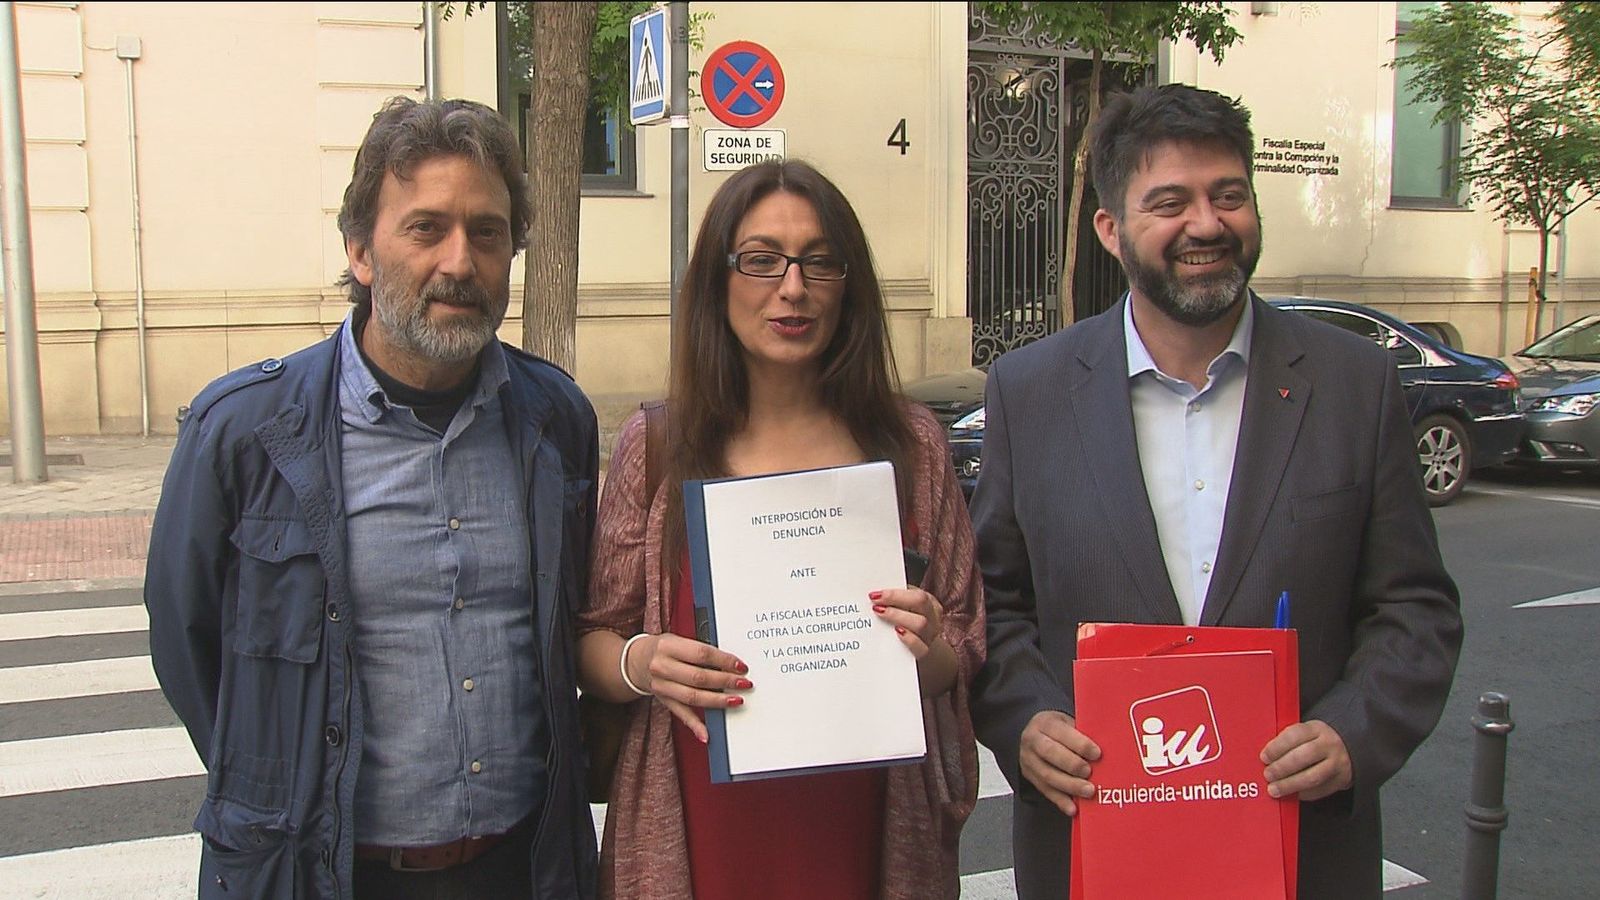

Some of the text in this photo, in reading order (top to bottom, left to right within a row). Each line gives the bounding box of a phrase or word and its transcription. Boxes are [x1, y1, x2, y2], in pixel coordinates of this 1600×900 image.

[717, 137, 772, 148] ZONA DE
[887, 118, 911, 155] 4
[1294, 139, 1325, 151] Especial
[1253, 151, 1274, 160] ontra
[1276, 151, 1283, 161] la
[1325, 155, 1331, 165] y
[1332, 155, 1339, 163] la
[1253, 163, 1339, 176] riminalidad Organizada
[751, 507, 843, 526] INTERPOSICIÓN DE
[773, 525, 826, 540] DENUNCIA
[790, 567, 817, 579] ANTE
[755, 604, 860, 623] LA FISCALIA ESPECIAL
[747, 618, 872, 640] CONTRA LA CORRUPCIÓN
[763, 640, 860, 659] Y LA CRIMINALIDAD
[780, 658, 848, 674] ORGANIZADA
[1097, 780, 1259, 808] izquierda-unida.es
